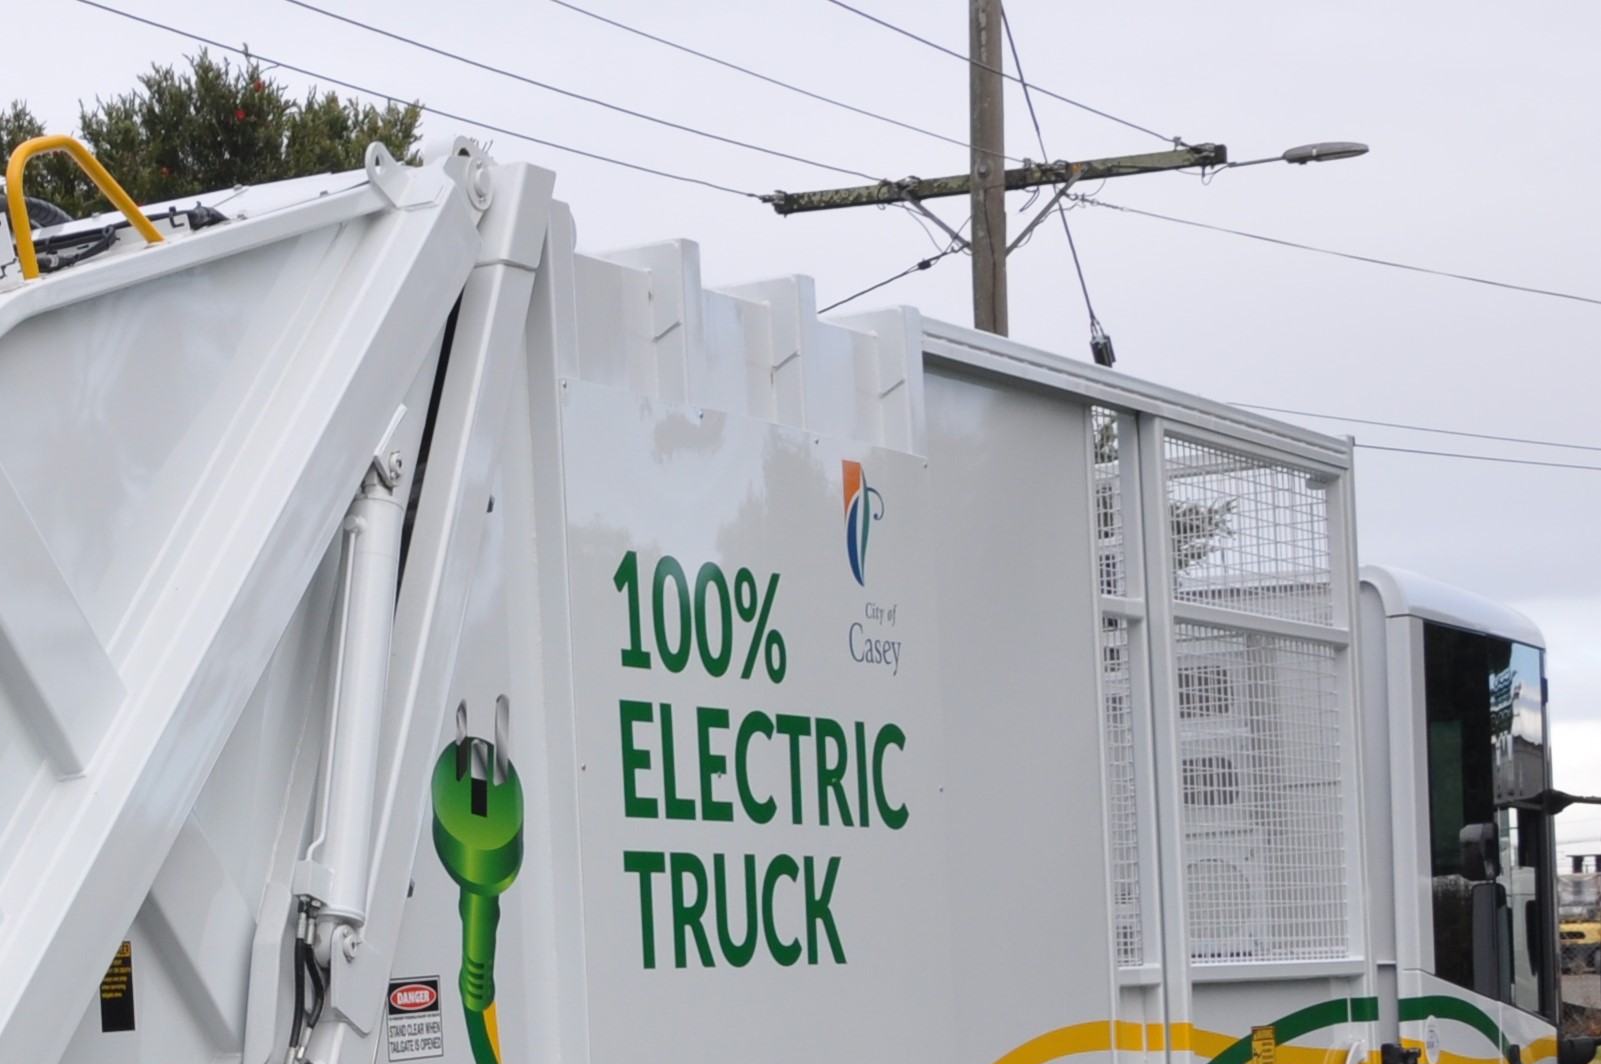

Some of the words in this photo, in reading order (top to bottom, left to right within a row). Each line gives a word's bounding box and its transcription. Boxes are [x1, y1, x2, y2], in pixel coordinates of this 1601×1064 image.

[612, 550, 787, 684] 100%
[865, 601, 884, 625] City
[887, 603, 898, 627] of
[849, 621, 902, 677] Casey
[618, 699, 910, 830] ELECTRIC
[622, 850, 848, 970] TRUCK
[397, 989, 430, 1005] DANGER
[389, 1025, 406, 1039] STAND
[407, 1022, 424, 1037] CLEAR
[425, 1020, 441, 1034] WHEN
[389, 1039, 414, 1054] TAILGATE
[421, 1036, 442, 1051] OPENED
